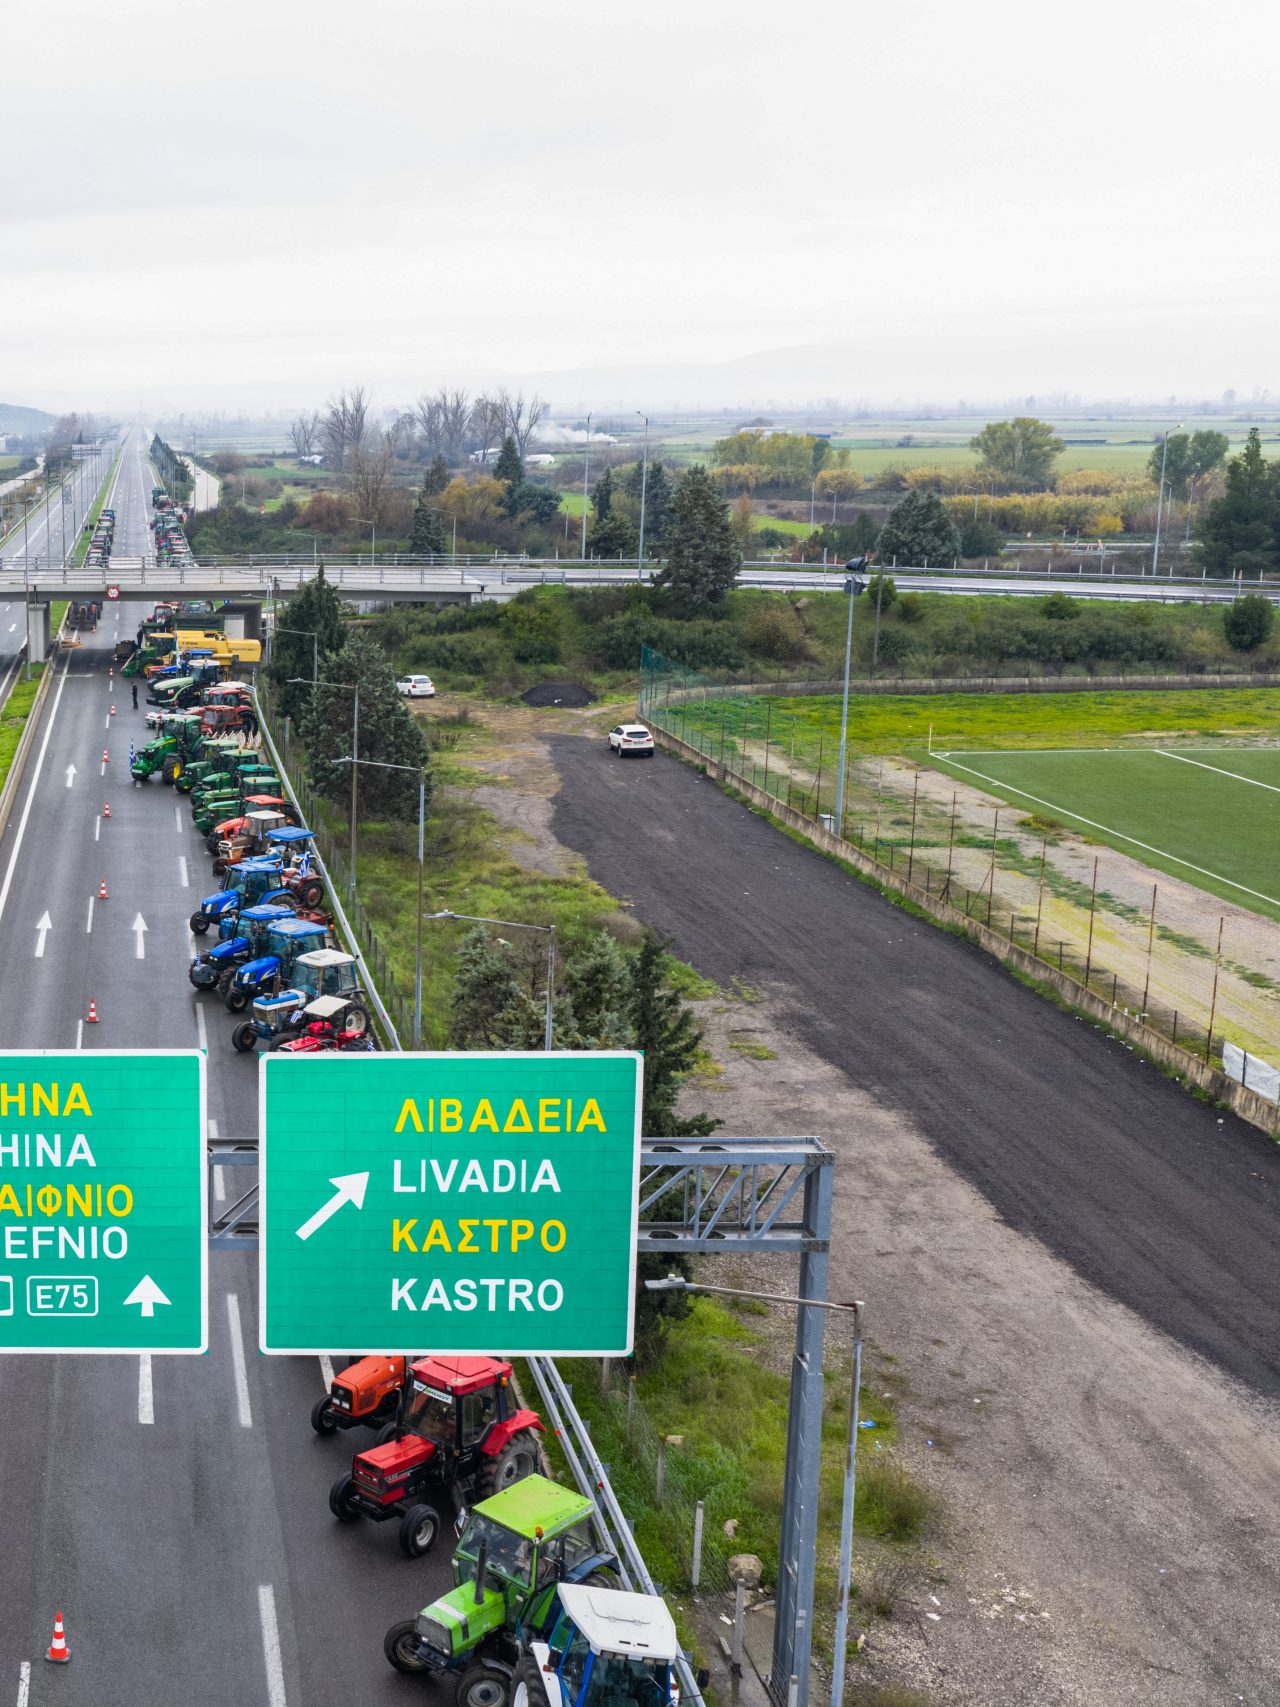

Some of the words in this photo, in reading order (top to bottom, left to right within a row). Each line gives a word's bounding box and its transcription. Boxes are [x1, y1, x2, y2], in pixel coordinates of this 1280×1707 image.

[394, 1098, 607, 1133] ΛΙΒΑΔΕΙΑ
[393, 1159, 561, 1193] LIVADIA
[392, 1218, 567, 1253] ΚΑΣΤΡΟ
[36, 1284, 88, 1309] E75
[391, 1278, 564, 1312] KASTRO
